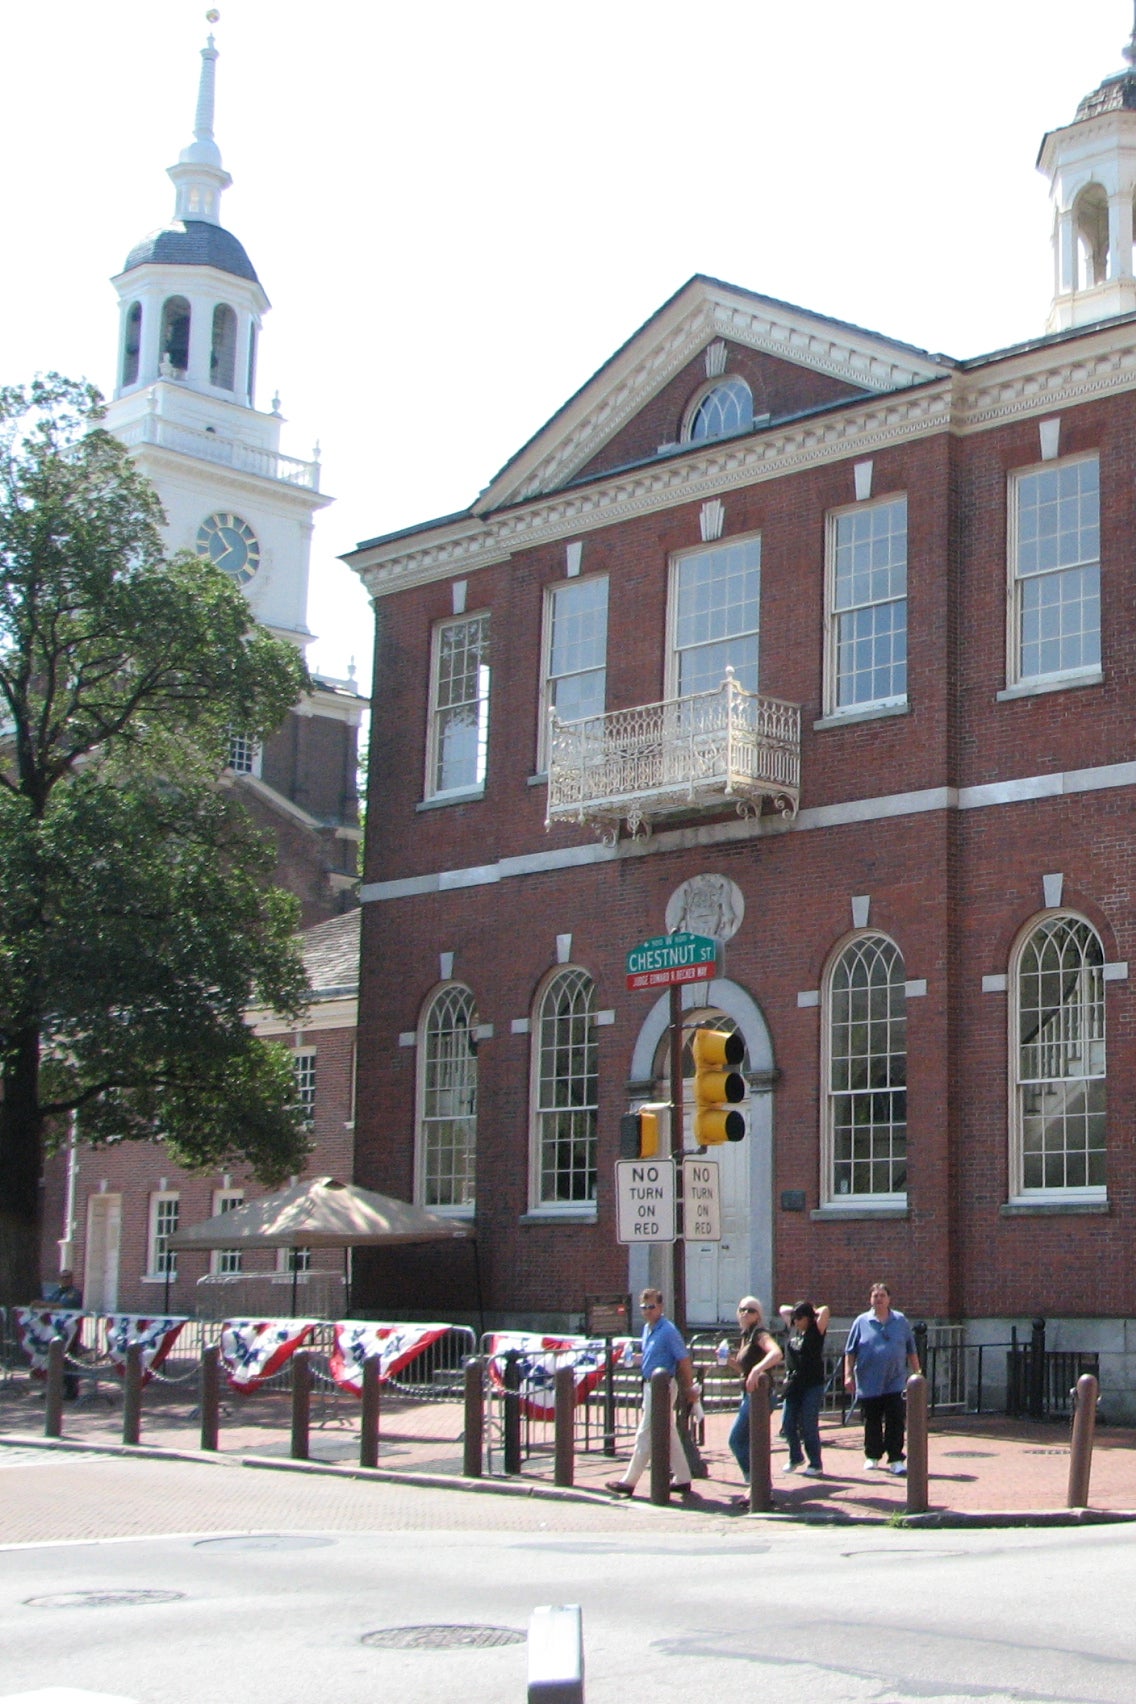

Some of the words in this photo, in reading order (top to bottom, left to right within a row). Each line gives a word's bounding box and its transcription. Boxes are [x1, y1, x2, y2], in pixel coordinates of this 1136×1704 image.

[629, 944, 695, 971] CHESTNUT
[700, 947, 711, 960] ST
[632, 1167, 659, 1182] NO
[693, 1167, 710, 1182] NO
[630, 1187, 663, 1200] TURN
[692, 1187, 713, 1199] TURN
[638, 1205, 655, 1217] ON
[697, 1204, 709, 1217] ON
[634, 1222, 659, 1235] RED
[695, 1222, 712, 1235] RED
